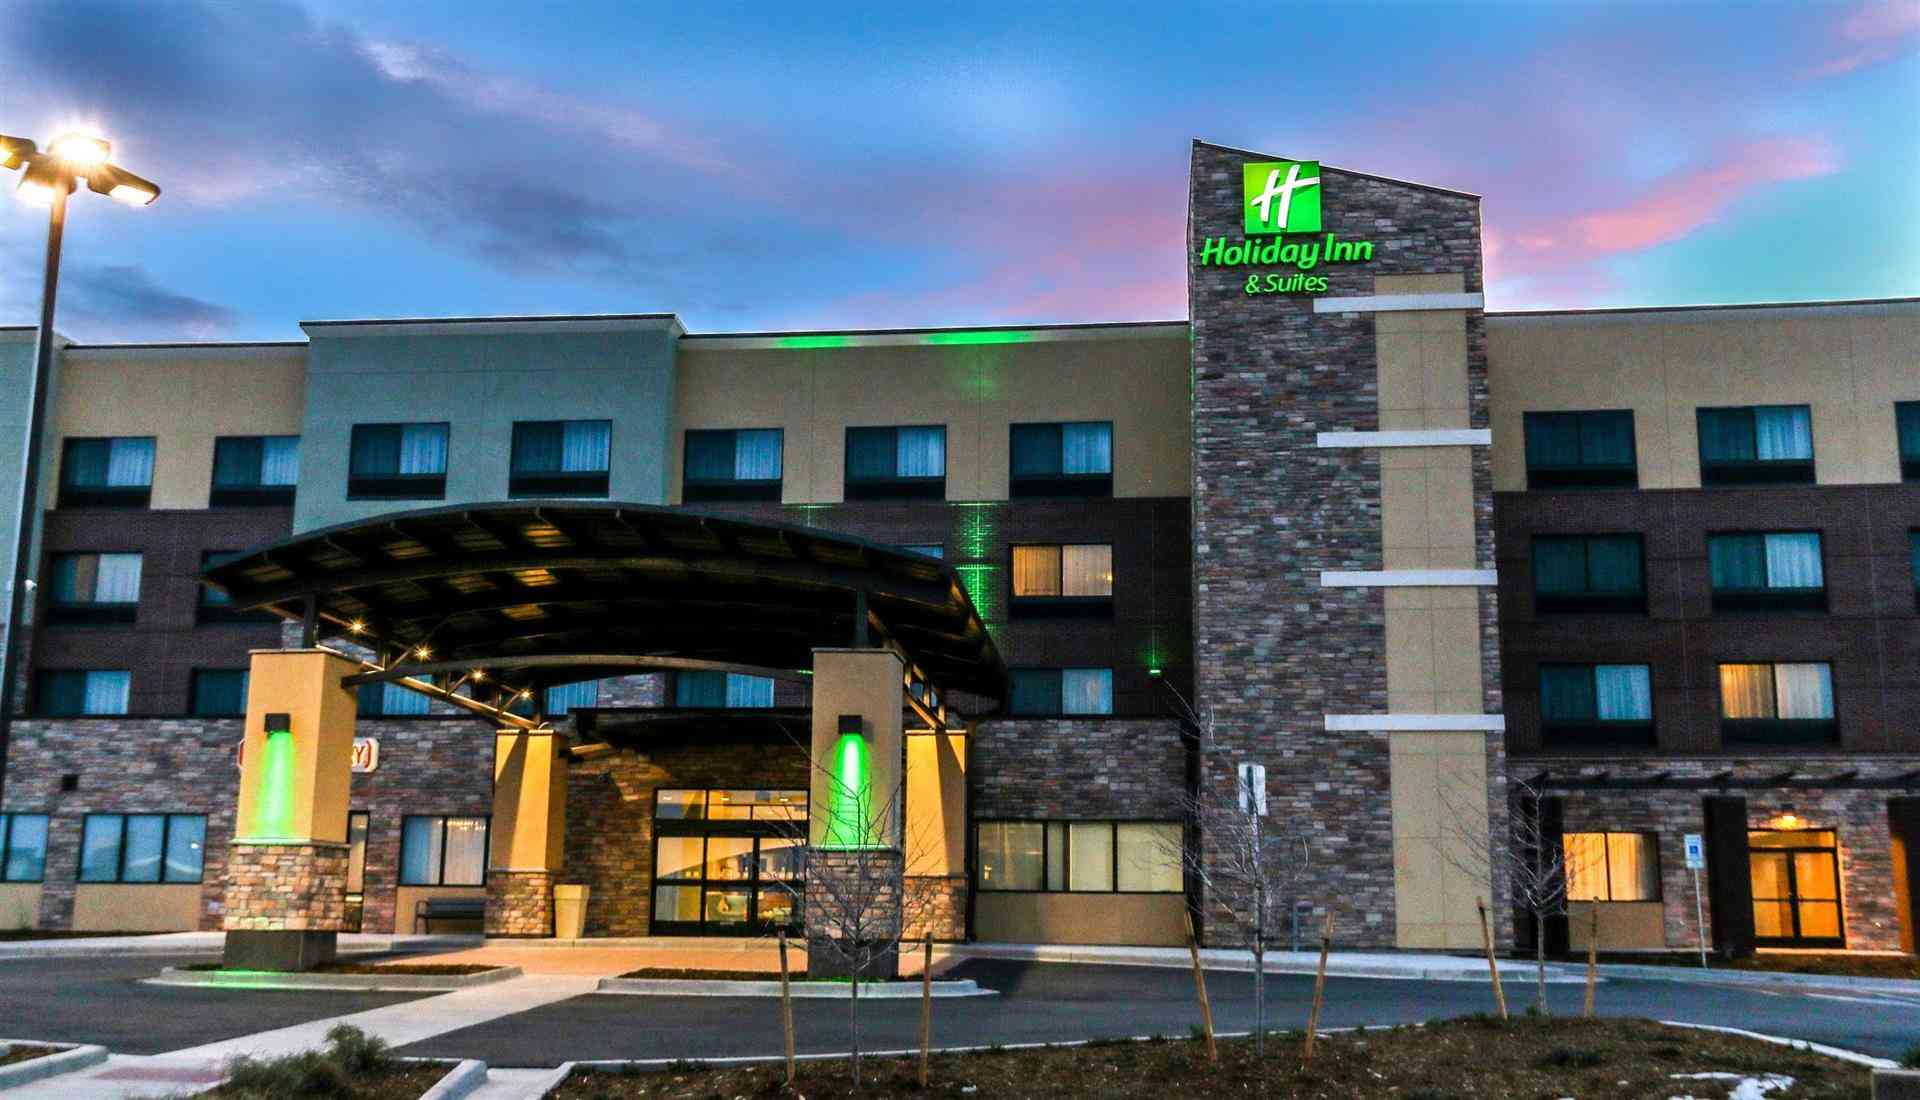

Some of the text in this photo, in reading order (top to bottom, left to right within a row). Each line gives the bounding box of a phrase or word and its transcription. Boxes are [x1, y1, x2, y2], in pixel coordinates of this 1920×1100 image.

[1251, 164, 1320, 229] H
[1200, 233, 1374, 269] Holiday Inn
[1245, 273, 1329, 294] & Suites
